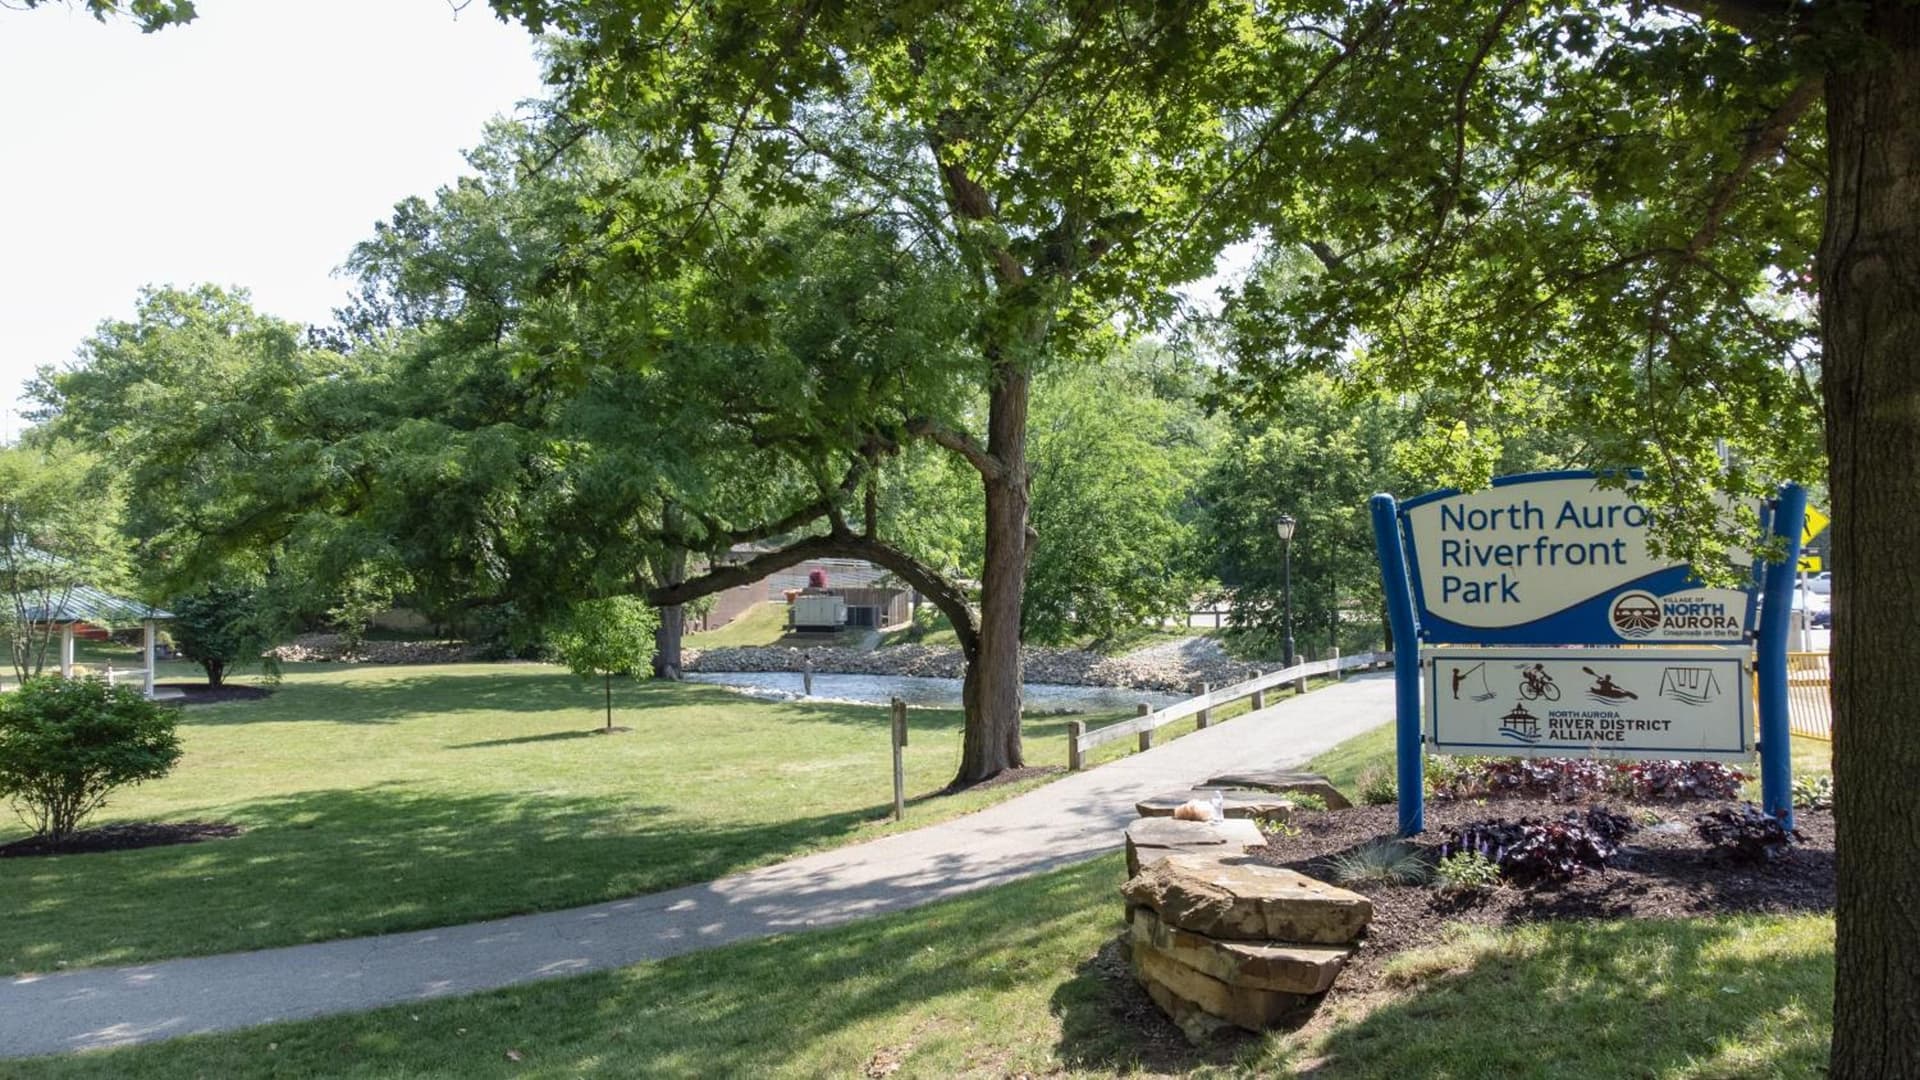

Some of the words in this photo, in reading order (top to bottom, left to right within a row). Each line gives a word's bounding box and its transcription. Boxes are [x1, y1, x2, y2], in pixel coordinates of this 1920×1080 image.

[1441, 500, 1544, 531] North
[1442, 536, 1627, 567] Riverfront
[1443, 573, 1520, 603] Park
[1663, 604, 1724, 616] NORTH
[1663, 617, 1739, 629] AURORA
[1581, 711, 1620, 719] AURORA
[1549, 719, 1595, 729] RIVER
[1600, 720, 1672, 731] DISTRICT
[1549, 730, 1625, 741] ALLIANCE
